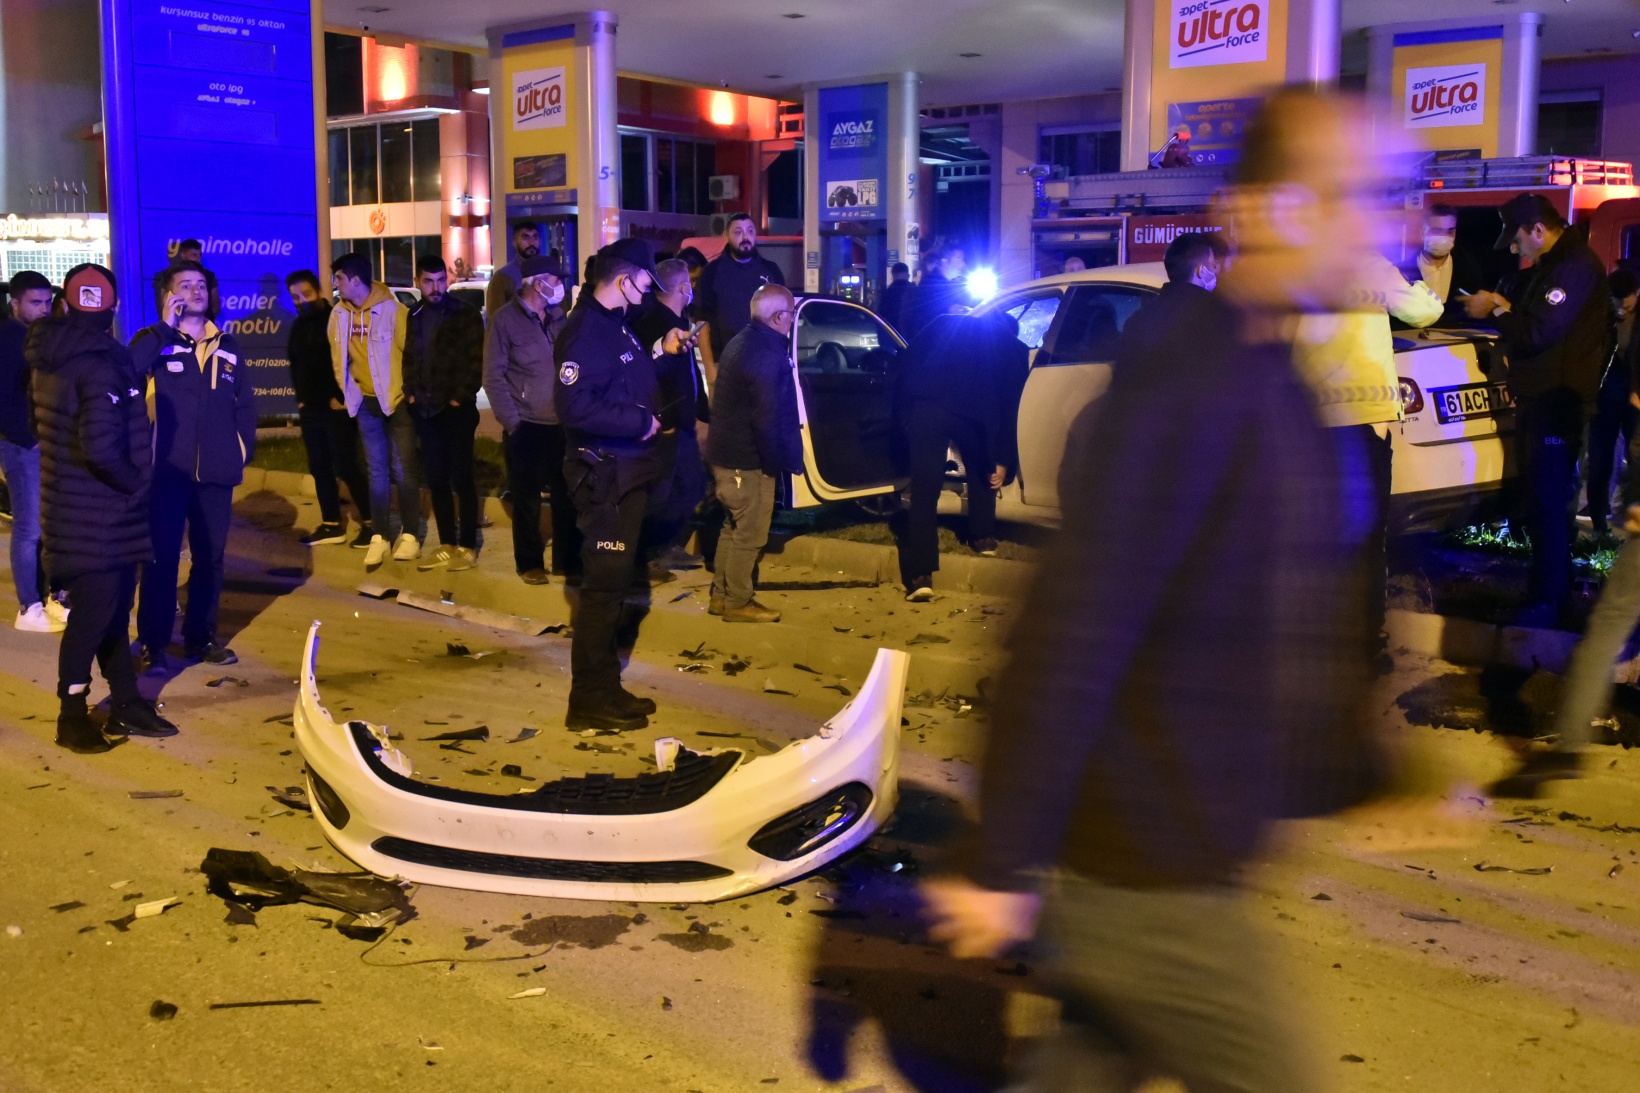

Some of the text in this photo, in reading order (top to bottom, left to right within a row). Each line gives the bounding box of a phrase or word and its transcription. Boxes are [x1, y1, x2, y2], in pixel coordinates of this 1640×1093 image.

[1179, 1, 1208, 16] opet
[160, 6, 285, 30] kurşunsuz benzin 95 oktan
[1178, 3, 1260, 48] ultra
[1226, 32, 1260, 48] force
[209, 82, 244, 94] oto lpg
[1412, 79, 1436, 90] opet
[517, 84, 561, 117] ultra
[1411, 82, 1478, 114] ultra
[543, 105, 561, 117] force
[1450, 102, 1478, 115] force
[832, 120, 873, 135] AYGAZ
[857, 191, 876, 206] LPG
[221, 293, 277, 310] enler
